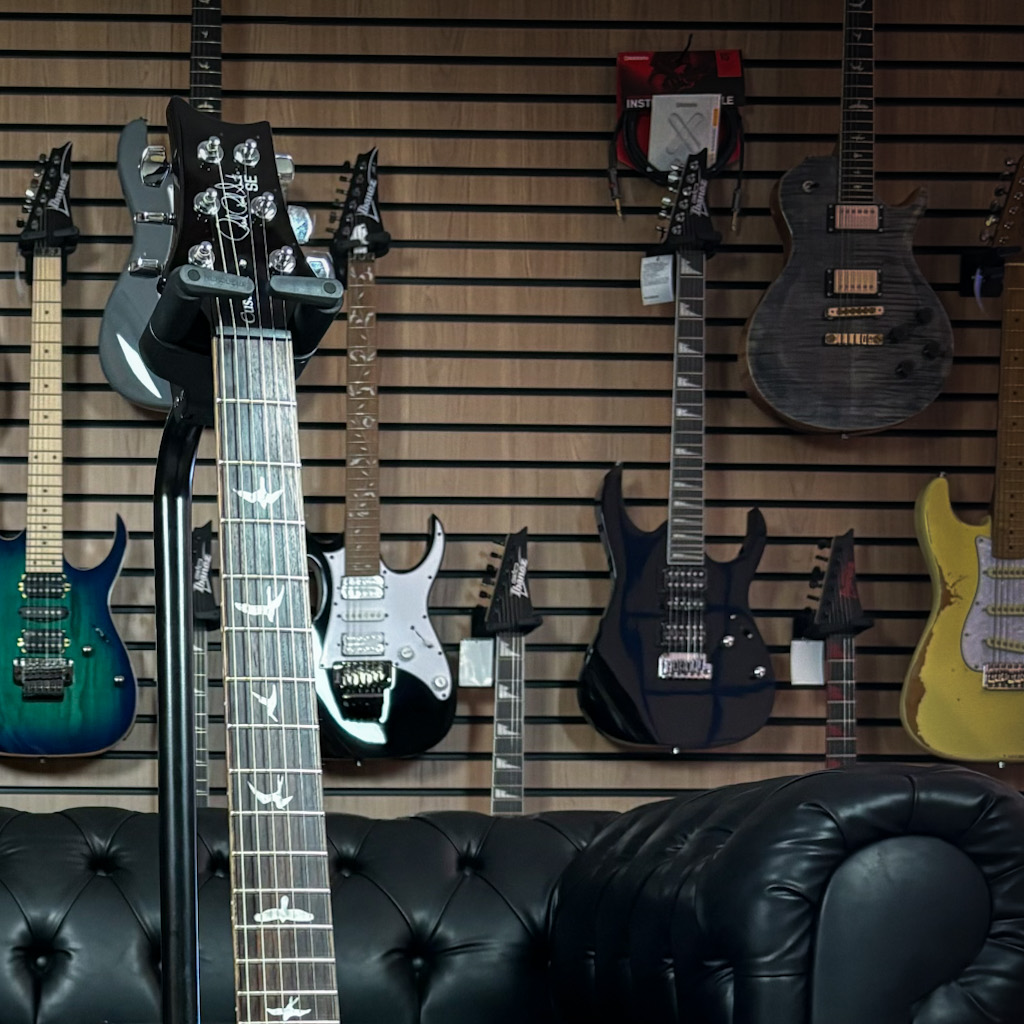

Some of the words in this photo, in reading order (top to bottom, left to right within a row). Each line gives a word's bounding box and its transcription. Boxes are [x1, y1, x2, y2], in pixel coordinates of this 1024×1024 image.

[46, 173, 70, 211] Ibanez
[244, 175, 259, 192] SE
[355, 179, 378, 216] Ibanez
[239, 295, 256, 324] Cus
[193, 553, 212, 593] Ibanez
[510, 558, 528, 598] Ibanez
